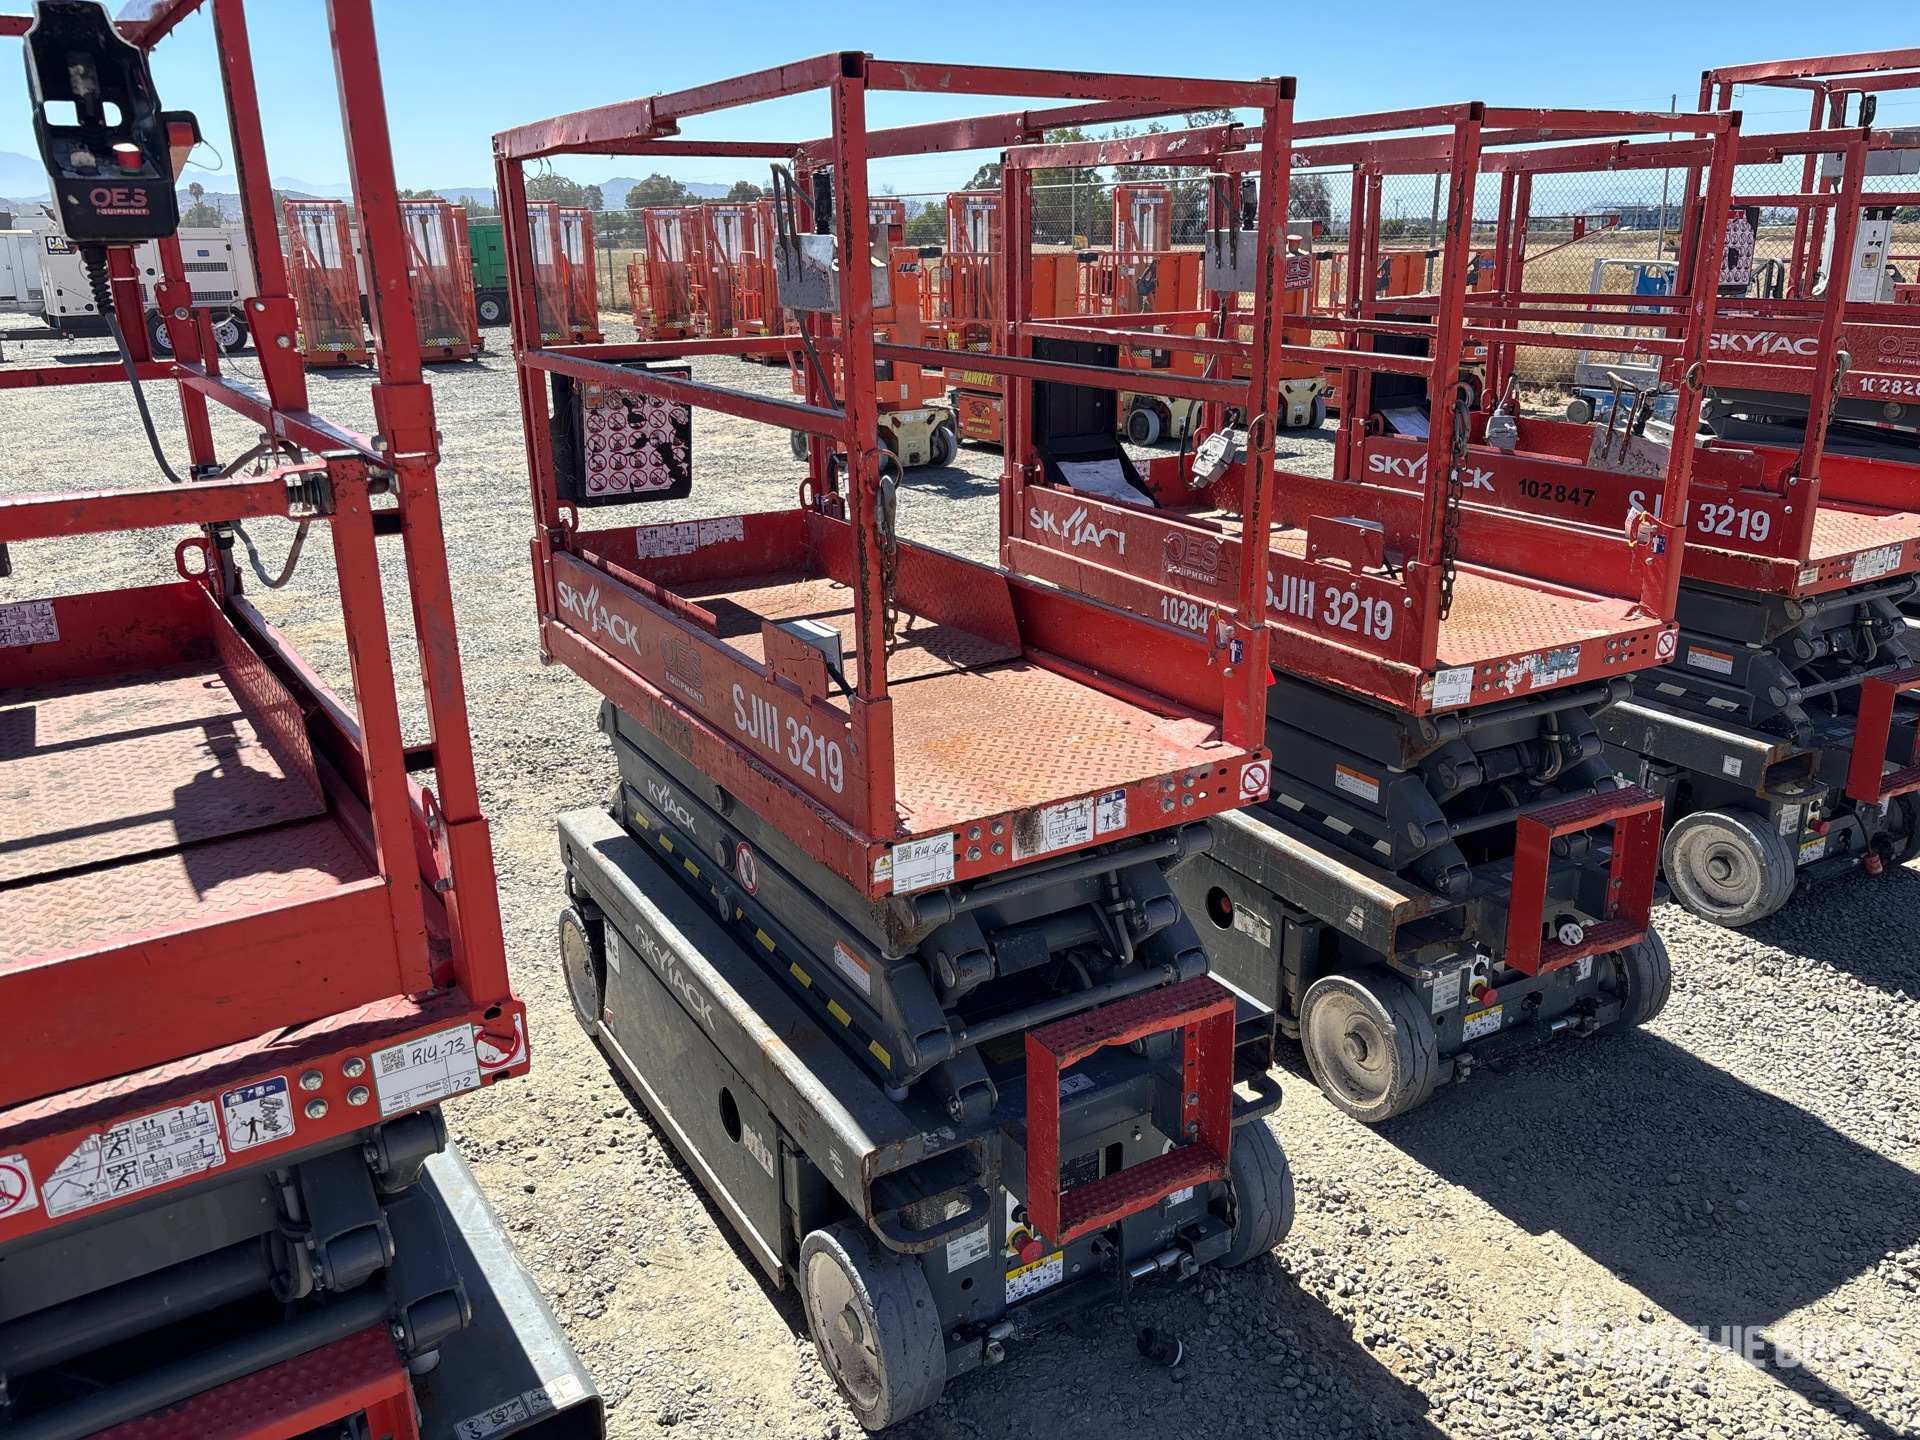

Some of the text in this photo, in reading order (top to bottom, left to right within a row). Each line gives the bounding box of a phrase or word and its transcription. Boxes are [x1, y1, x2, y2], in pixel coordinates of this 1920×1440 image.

[89, 188, 148, 207] OES
[96, 208, 148, 216] QUIPMENT
[897, 263, 918, 273] JLG
[1286, 256, 1311, 279] ES
[1285, 279, 1310, 288] UIPMENT
[1709, 331, 1819, 357] SKYJAC
[1878, 335, 1920, 357] OE
[1878, 357, 1920, 366] EQUIPME
[963, 370, 995, 387] HAWKEYE
[1319, 386, 1335, 398] LG
[1368, 451, 1496, 492] SKYJCK
[1518, 478, 1596, 507] 102847
[1697, 503, 1771, 542] 3219
[1165, 532, 1219, 572] OES
[557, 581, 642, 656] SKYJACK
[1323, 586, 1394, 641] 3219
[660, 631, 704, 689] OES
[665, 671, 705, 703] EQUIPMENT
[786, 716, 844, 794] 3219
[634, 923, 716, 1032] SKYJACK
[412, 1036, 466, 1065] R14-73
